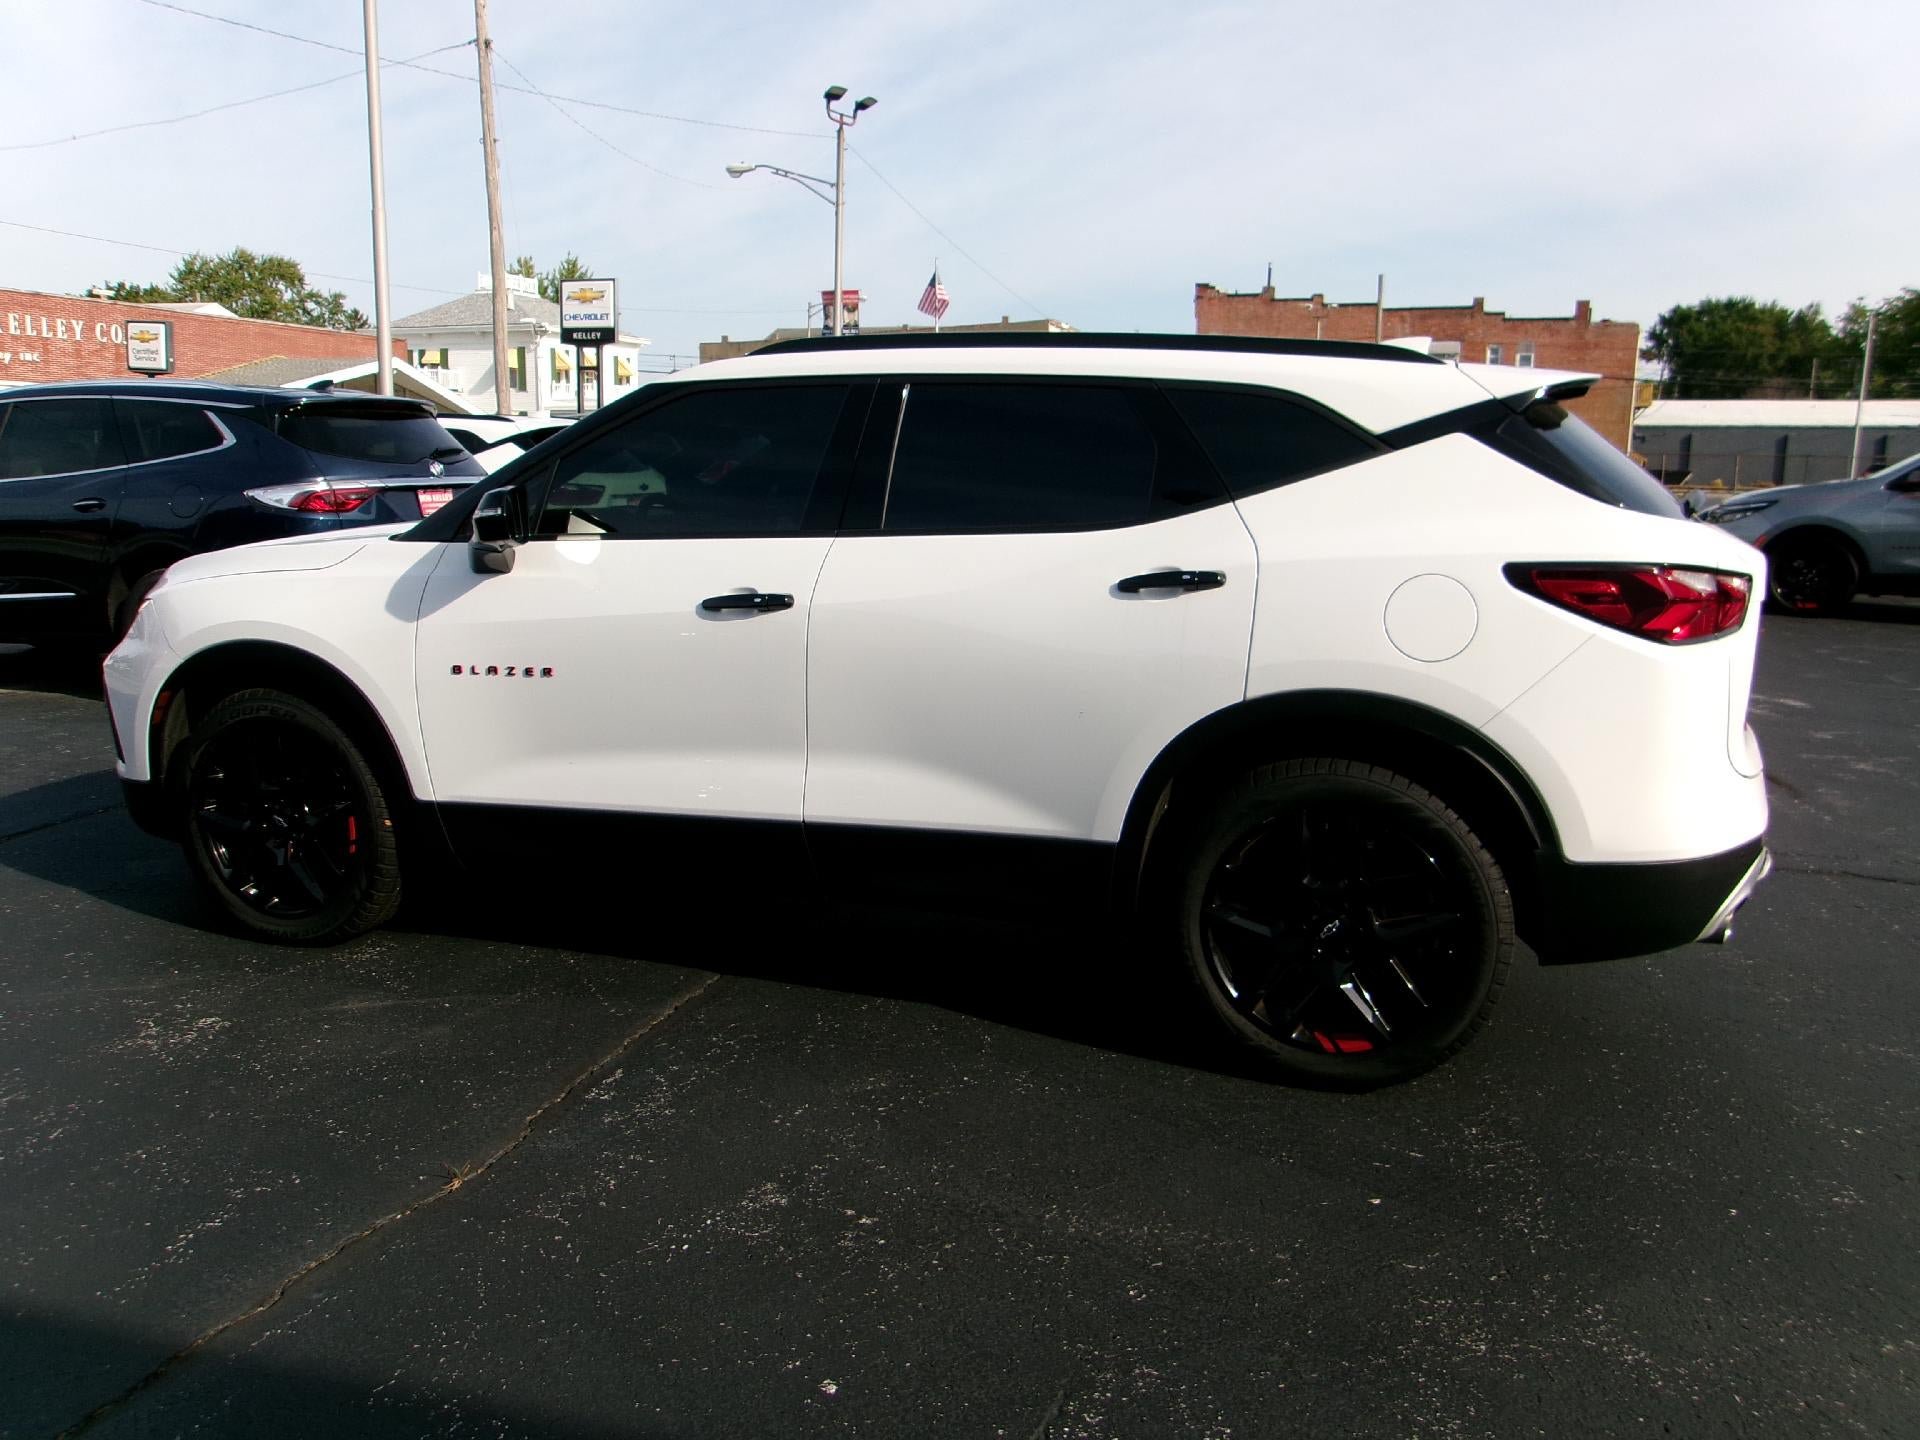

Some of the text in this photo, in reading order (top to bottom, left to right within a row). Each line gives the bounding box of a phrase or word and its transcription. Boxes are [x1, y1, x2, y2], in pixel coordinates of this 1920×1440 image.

[564, 313, 609, 321] CHEVROLET
[0, 313, 127, 345] ELLEY CO.
[572, 332, 601, 340] KELLEY
[132, 347, 159, 355] Certified
[133, 354, 158, 362] Service
[449, 664, 555, 679] BLAZER
